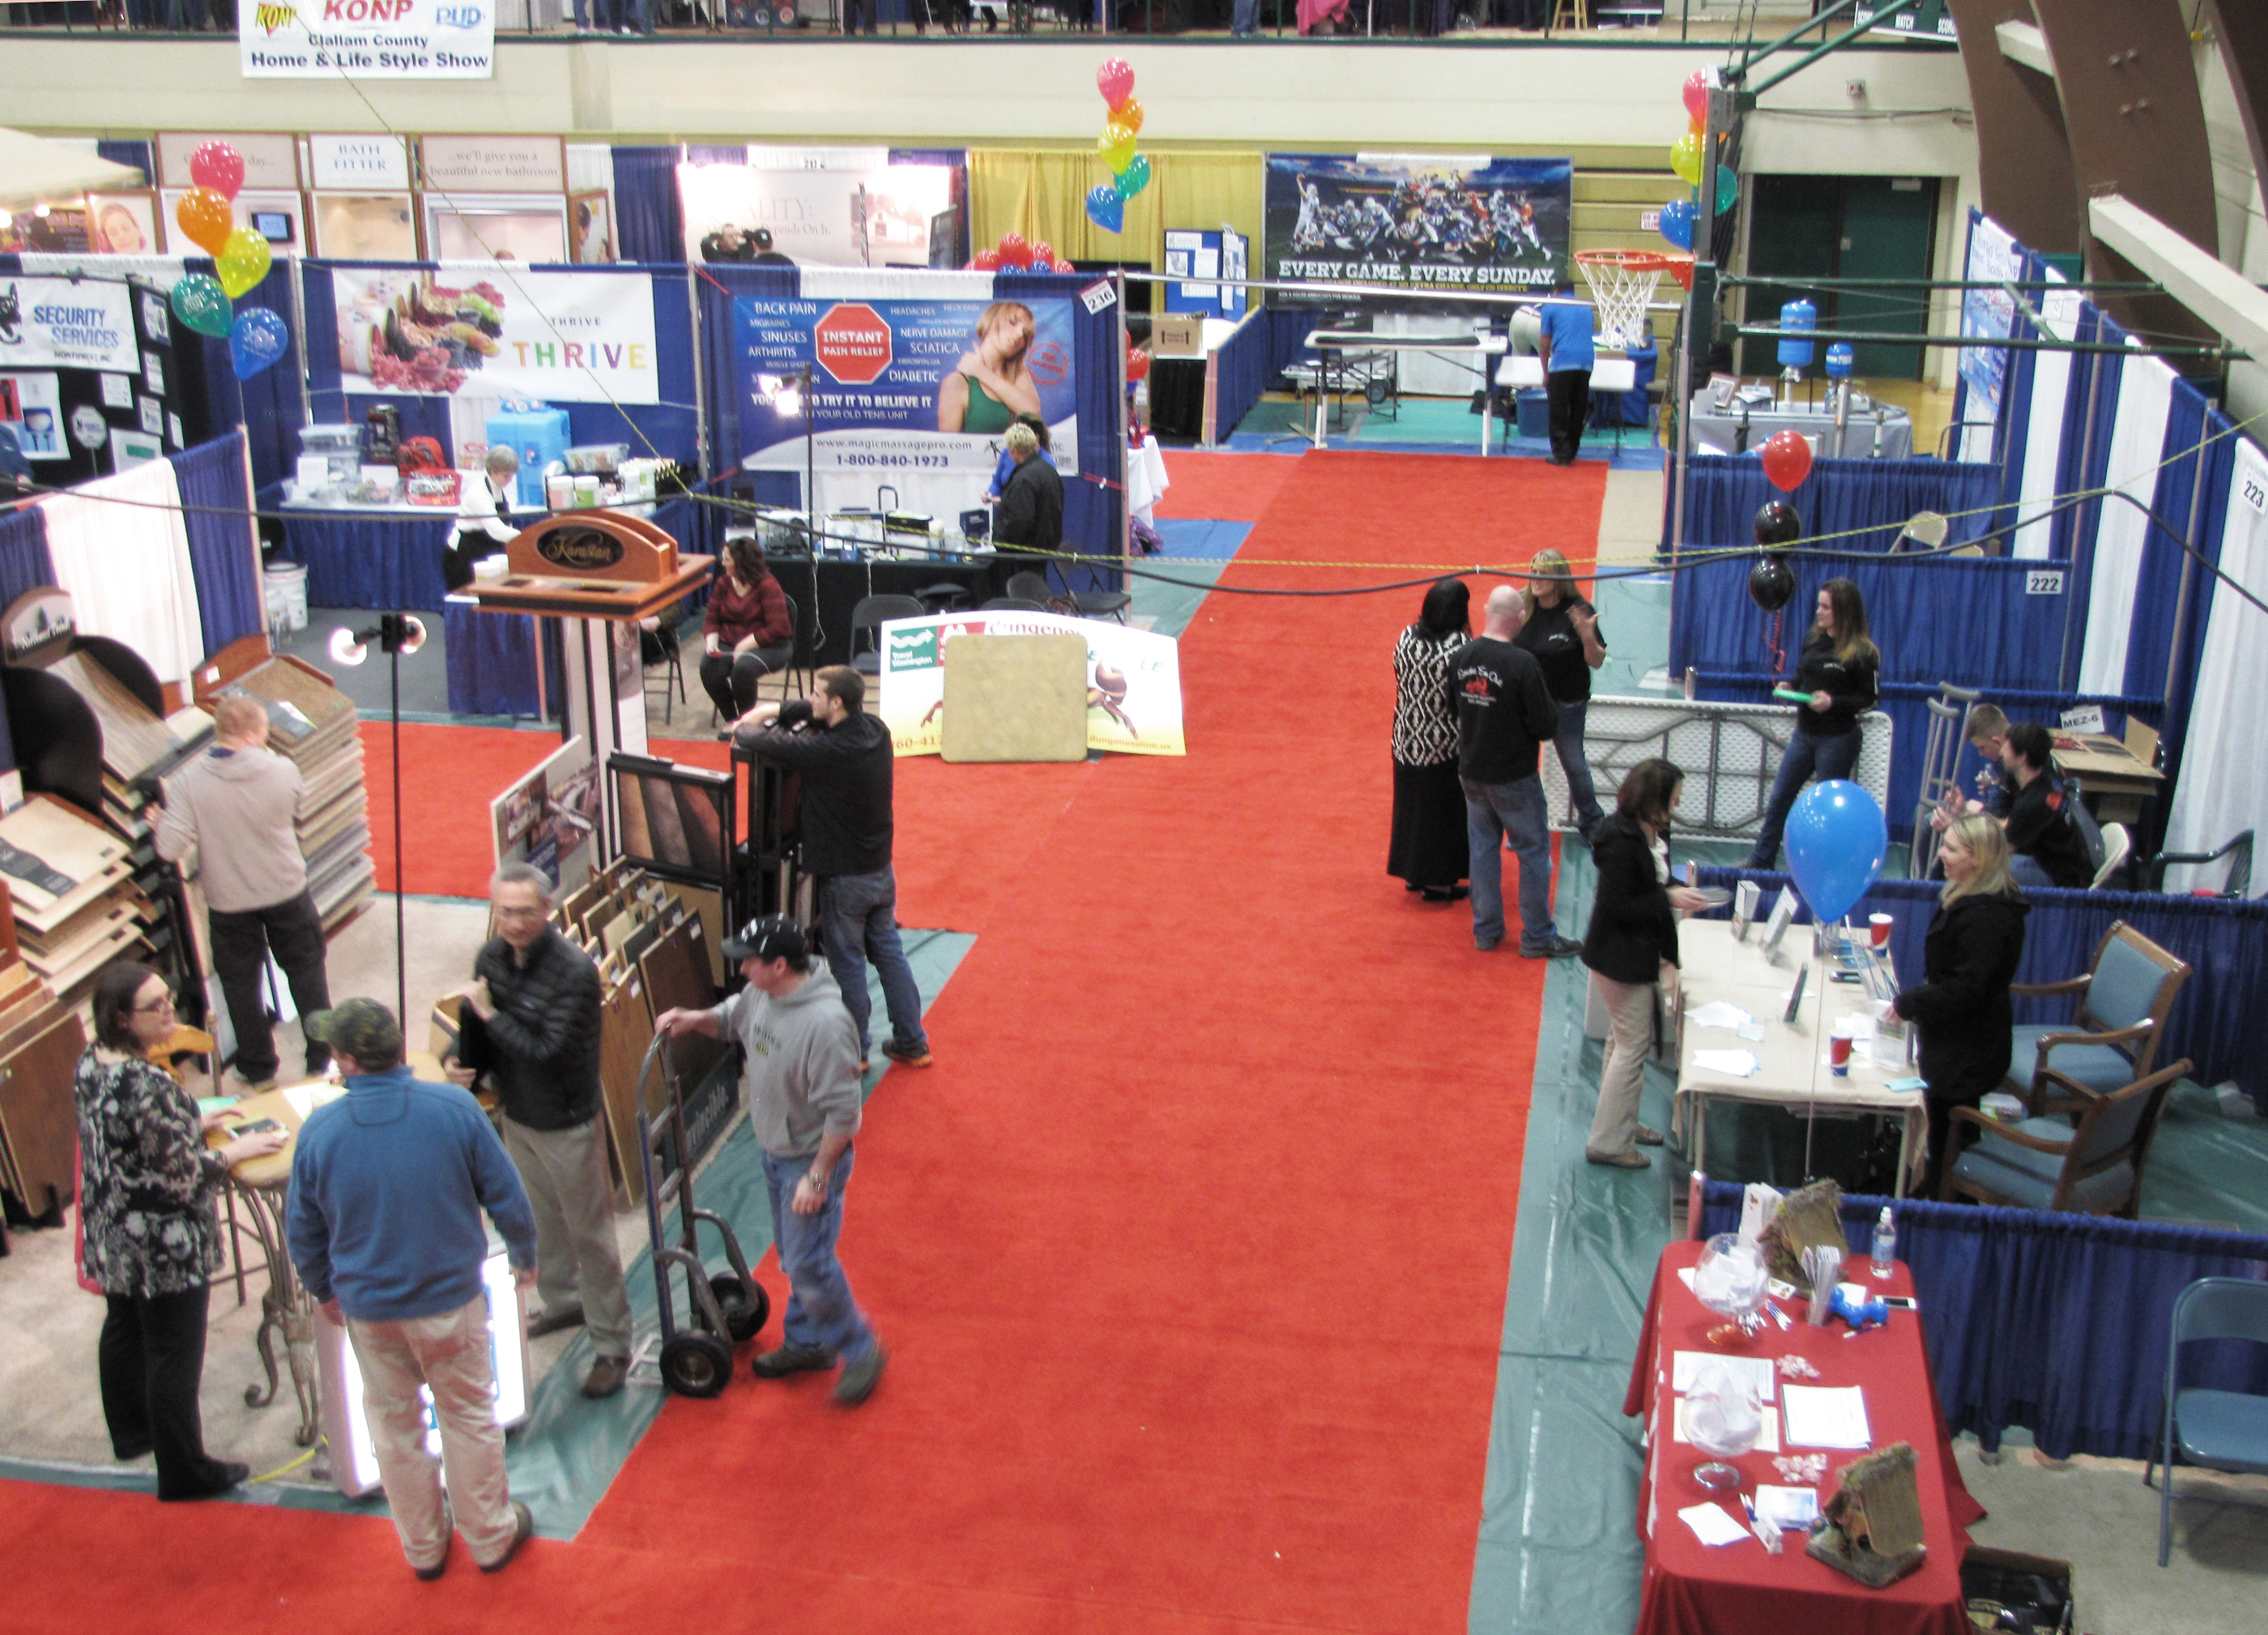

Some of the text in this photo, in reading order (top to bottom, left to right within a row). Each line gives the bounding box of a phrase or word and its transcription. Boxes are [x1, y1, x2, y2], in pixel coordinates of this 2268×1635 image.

[323, 0, 414, 21] KONP
[1895, 14, 1915, 32] MATCH
[373, 35, 428, 49] County
[251, 52, 488, 70] Home & Life Style Show
[339, 143, 381, 155] BATH
[484, 152, 507, 164] give
[509, 152, 531, 163] you
[334, 159, 386, 171] FITTER
[430, 165, 557, 177] beautiful new bathroom
[803, 224, 818, 235] On
[1278, 260, 1555, 285] EVERY GAME. EVERY SUNDAY.
[1088, 292, 1113, 309] 236
[755, 302, 817, 315] BACK PAIN
[891, 307, 936, 316] HEADACHES
[943, 303, 980, 313] NECK PAIN
[34, 305, 106, 327] SECURITY
[551, 317, 601, 327] THRIVE
[750, 318, 791, 328] MIGRAINES
[50, 326, 119, 348] SERVICES
[761, 331, 808, 344] SINUSES
[822, 331, 885, 344] INSTANT
[901, 327, 969, 339] NERVE DAMAGE
[748, 346, 796, 359] ARTHRITIS
[823, 347, 885, 356] PAIN RELIEF
[910, 341, 961, 354] SCIATICA
[513, 342, 648, 370] THRIVE
[889, 369, 940, 382] DIABETIC
[821, 394, 842, 407] TRY
[845, 395, 856, 407] IT
[858, 395, 872, 408] TO
[875, 395, 919, 409] BELIEVE
[921, 396, 932, 408] IT
[843, 410, 861, 419] OLD
[863, 411, 886, 420] TENS
[888, 411, 909, 420] UNIT
[816, 438, 971, 451] www.magicmassagepro.com
[837, 453, 949, 468] 1-800-840-1973
[2244, 480, 2264, 509] 223
[2031, 578, 2058, 591] 222
[892, 650, 914, 660] Travel
[892, 655, 933, 668] Washington
[2062, 714, 2099, 728] MEZ-6
